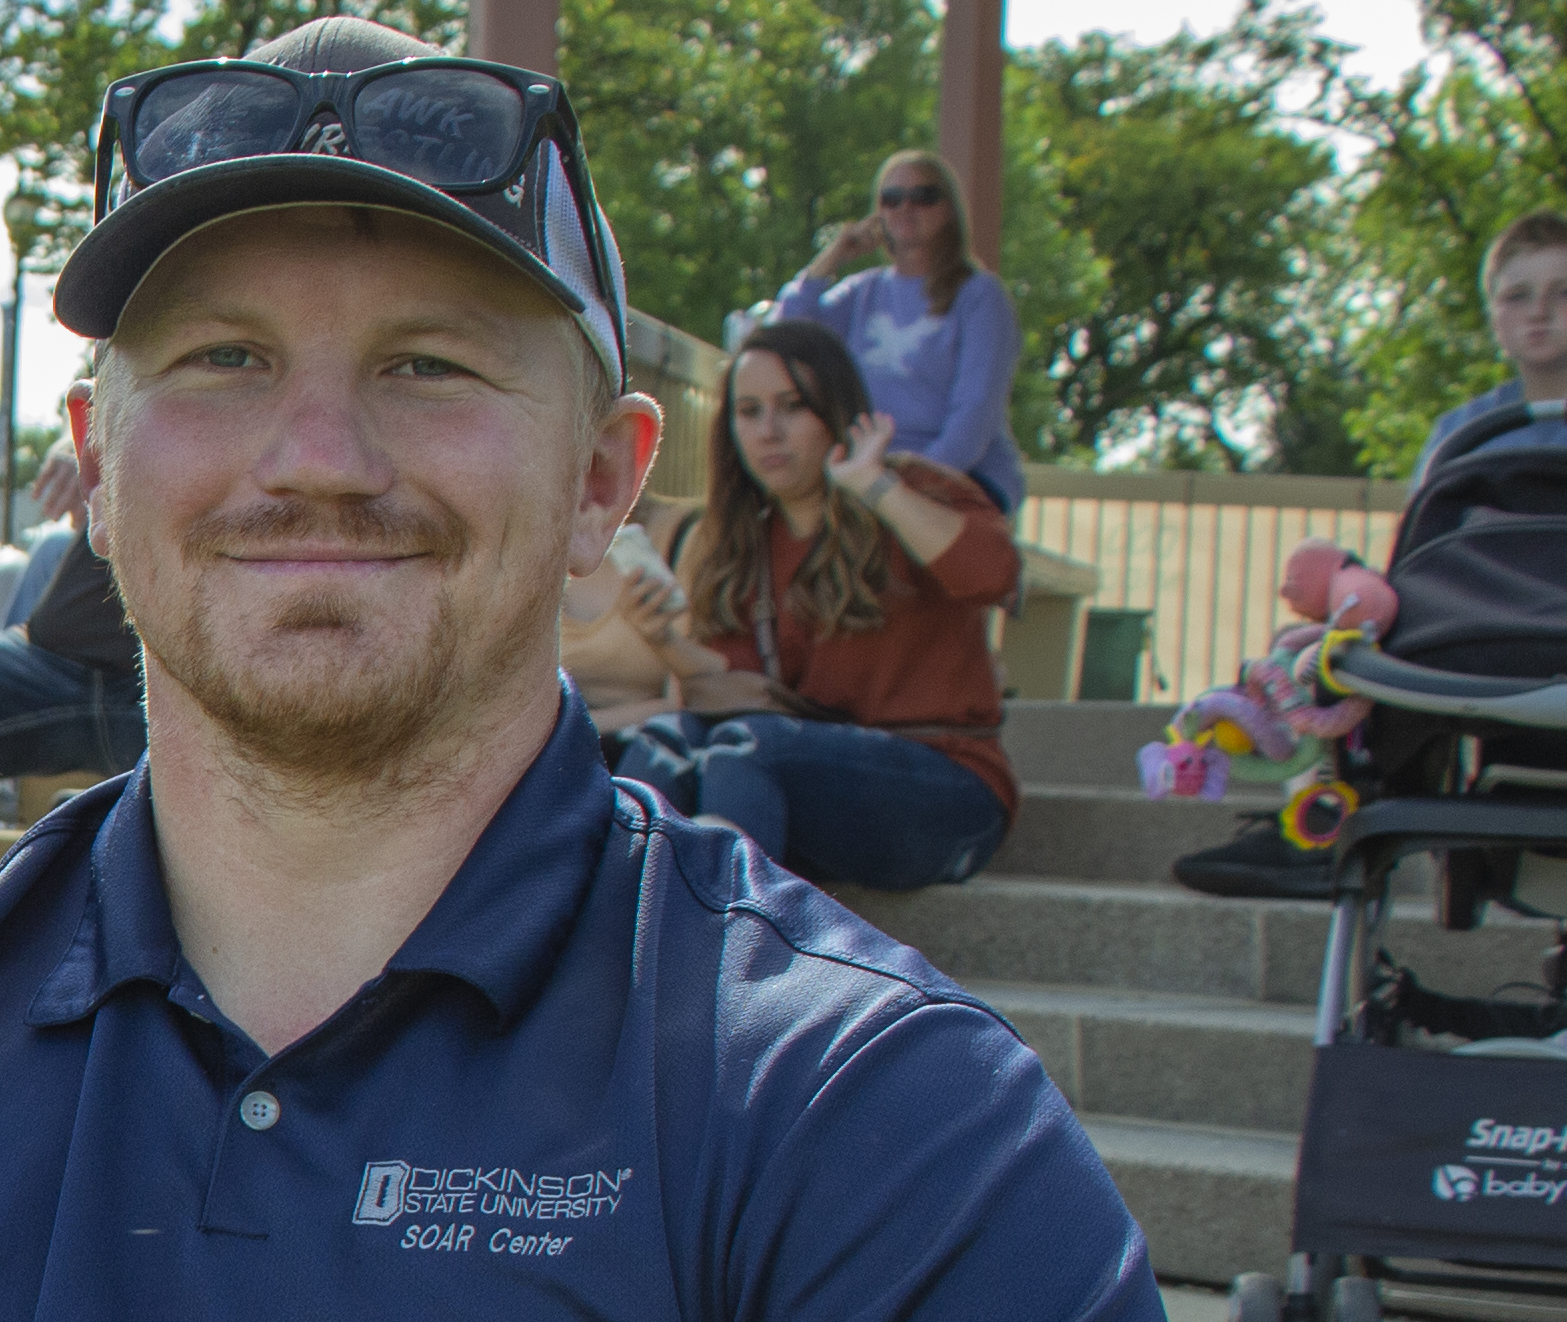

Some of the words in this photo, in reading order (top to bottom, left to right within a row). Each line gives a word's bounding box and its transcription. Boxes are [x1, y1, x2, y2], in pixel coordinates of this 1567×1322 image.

[404, 1193, 475, 1214] STATE
[480, 1194, 623, 1220] UNIVERSITY
[401, 1222, 475, 1252] SOAR
[489, 1227, 574, 1256] Center
